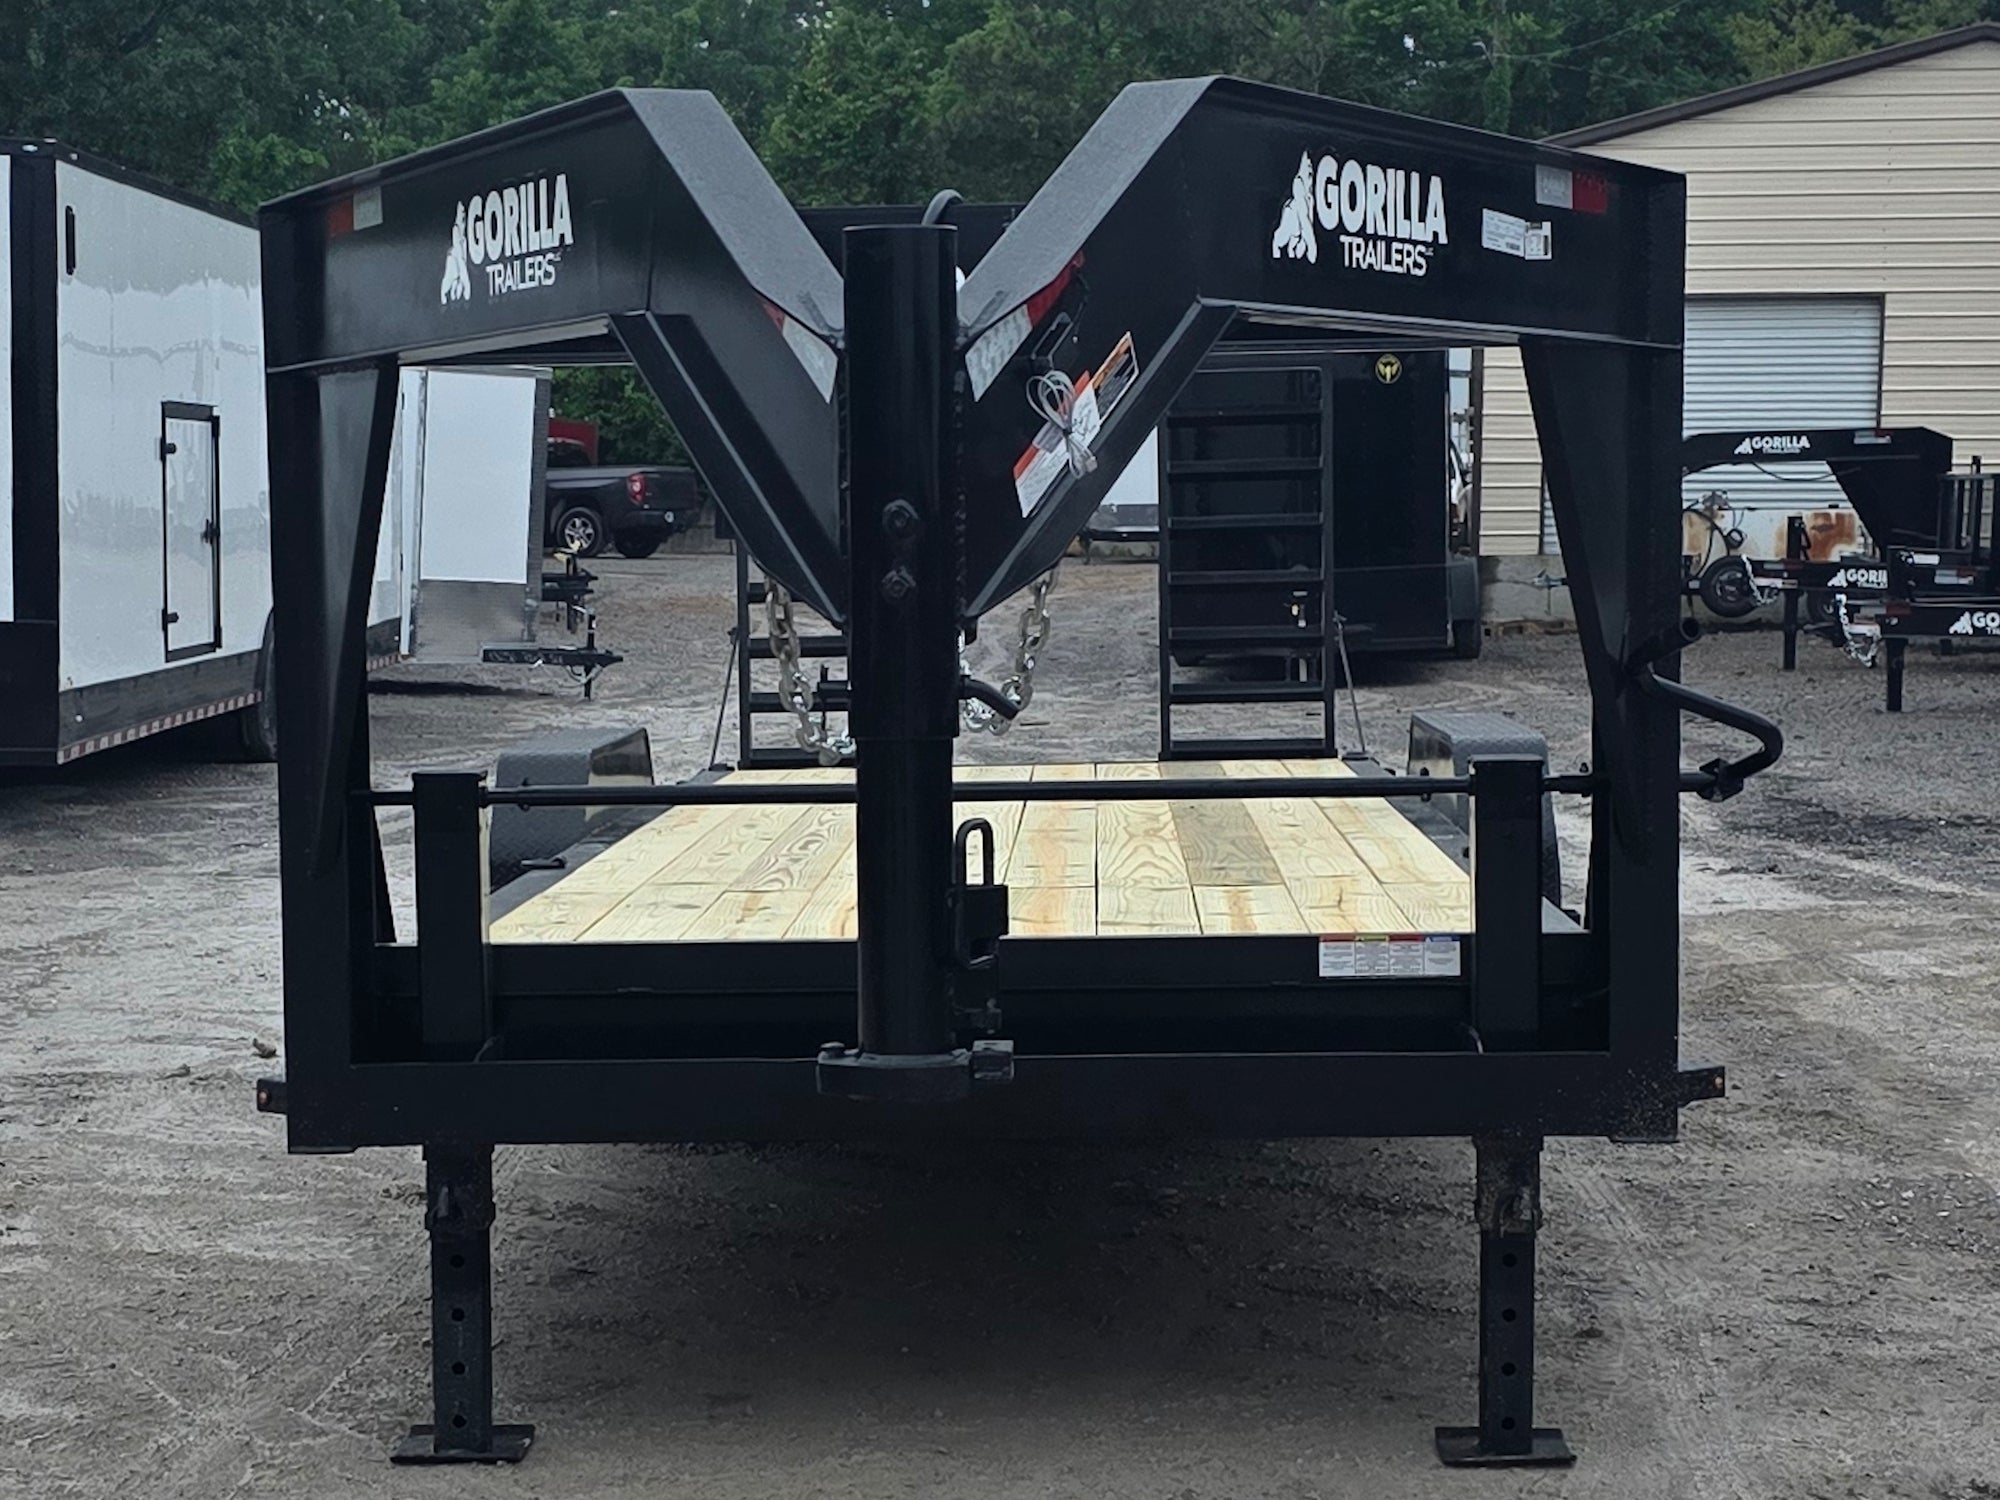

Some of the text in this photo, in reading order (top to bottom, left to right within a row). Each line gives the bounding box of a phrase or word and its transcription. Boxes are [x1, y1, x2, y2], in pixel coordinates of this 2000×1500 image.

[467, 173, 573, 264] GORILLA
[1315, 155, 1448, 244] GORILLA
[486, 252, 556, 297] TRAILERS
[1339, 235, 1427, 276] TRAILERS
[1752, 435, 1811, 449] GORILLA
